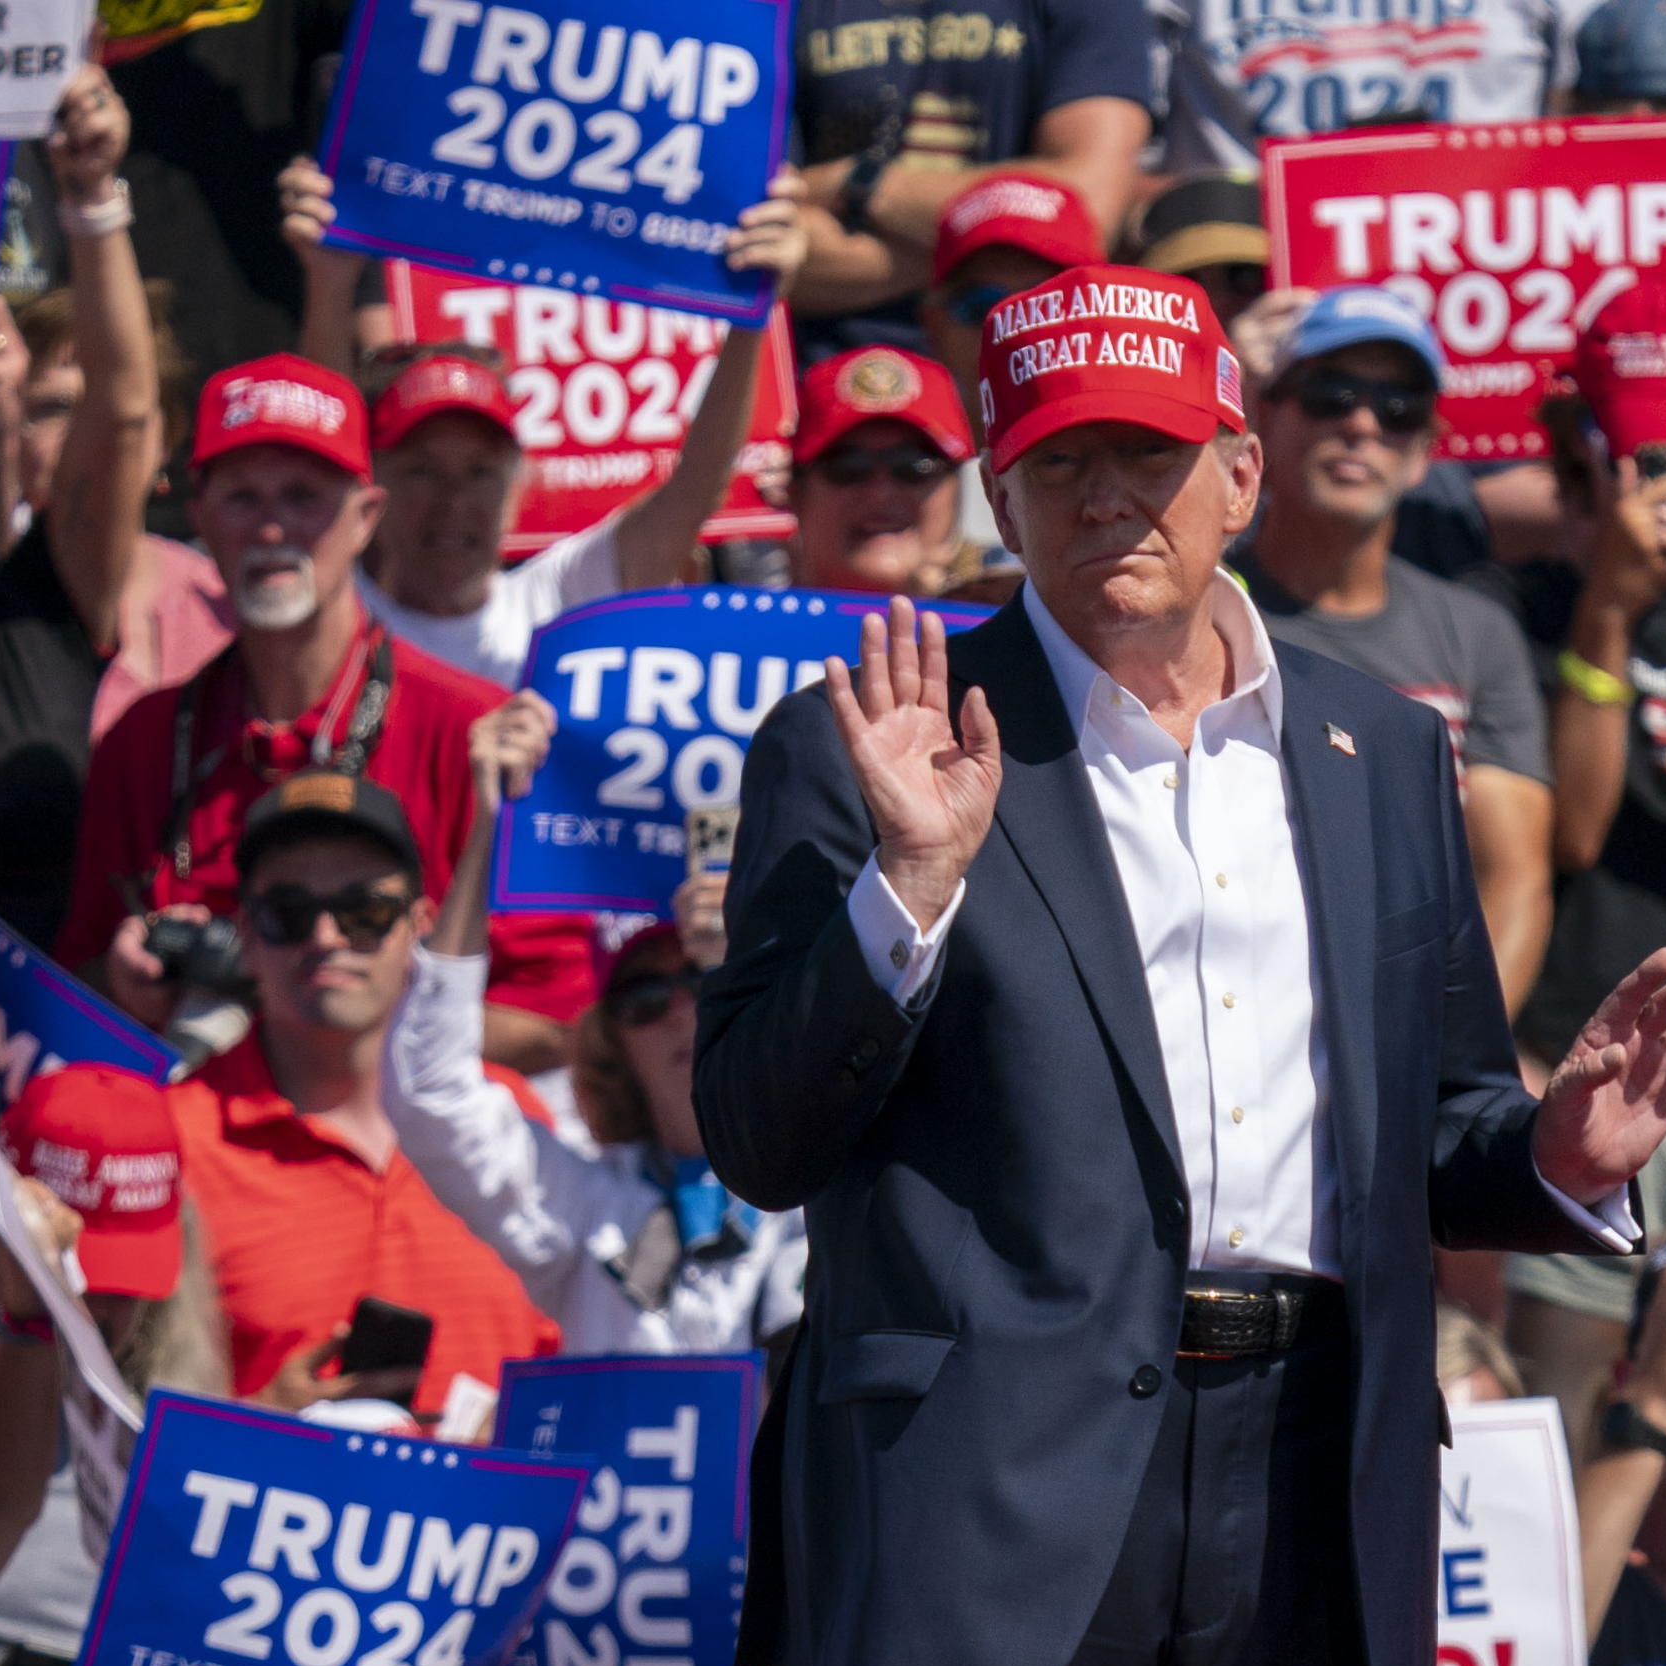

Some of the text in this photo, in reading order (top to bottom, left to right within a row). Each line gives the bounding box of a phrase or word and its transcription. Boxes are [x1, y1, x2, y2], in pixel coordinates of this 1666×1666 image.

[410, 0, 760, 125] TRUMP
[432, 84, 704, 203] 2024
[364, 156, 732, 255] TEXT TRUMP TO 8802
[441, 286, 731, 365] TRUM
[991, 282, 1201, 345] MAKE AMERICA
[1008, 331, 1185, 387] GREAT AGAIN
[1438, 359, 1535, 399] RUMP
[555, 646, 825, 738] TRU
[597, 725, 747, 811] 20
[532, 811, 626, 847] TEXT
[182, 1469, 540, 1608] TRUMP
